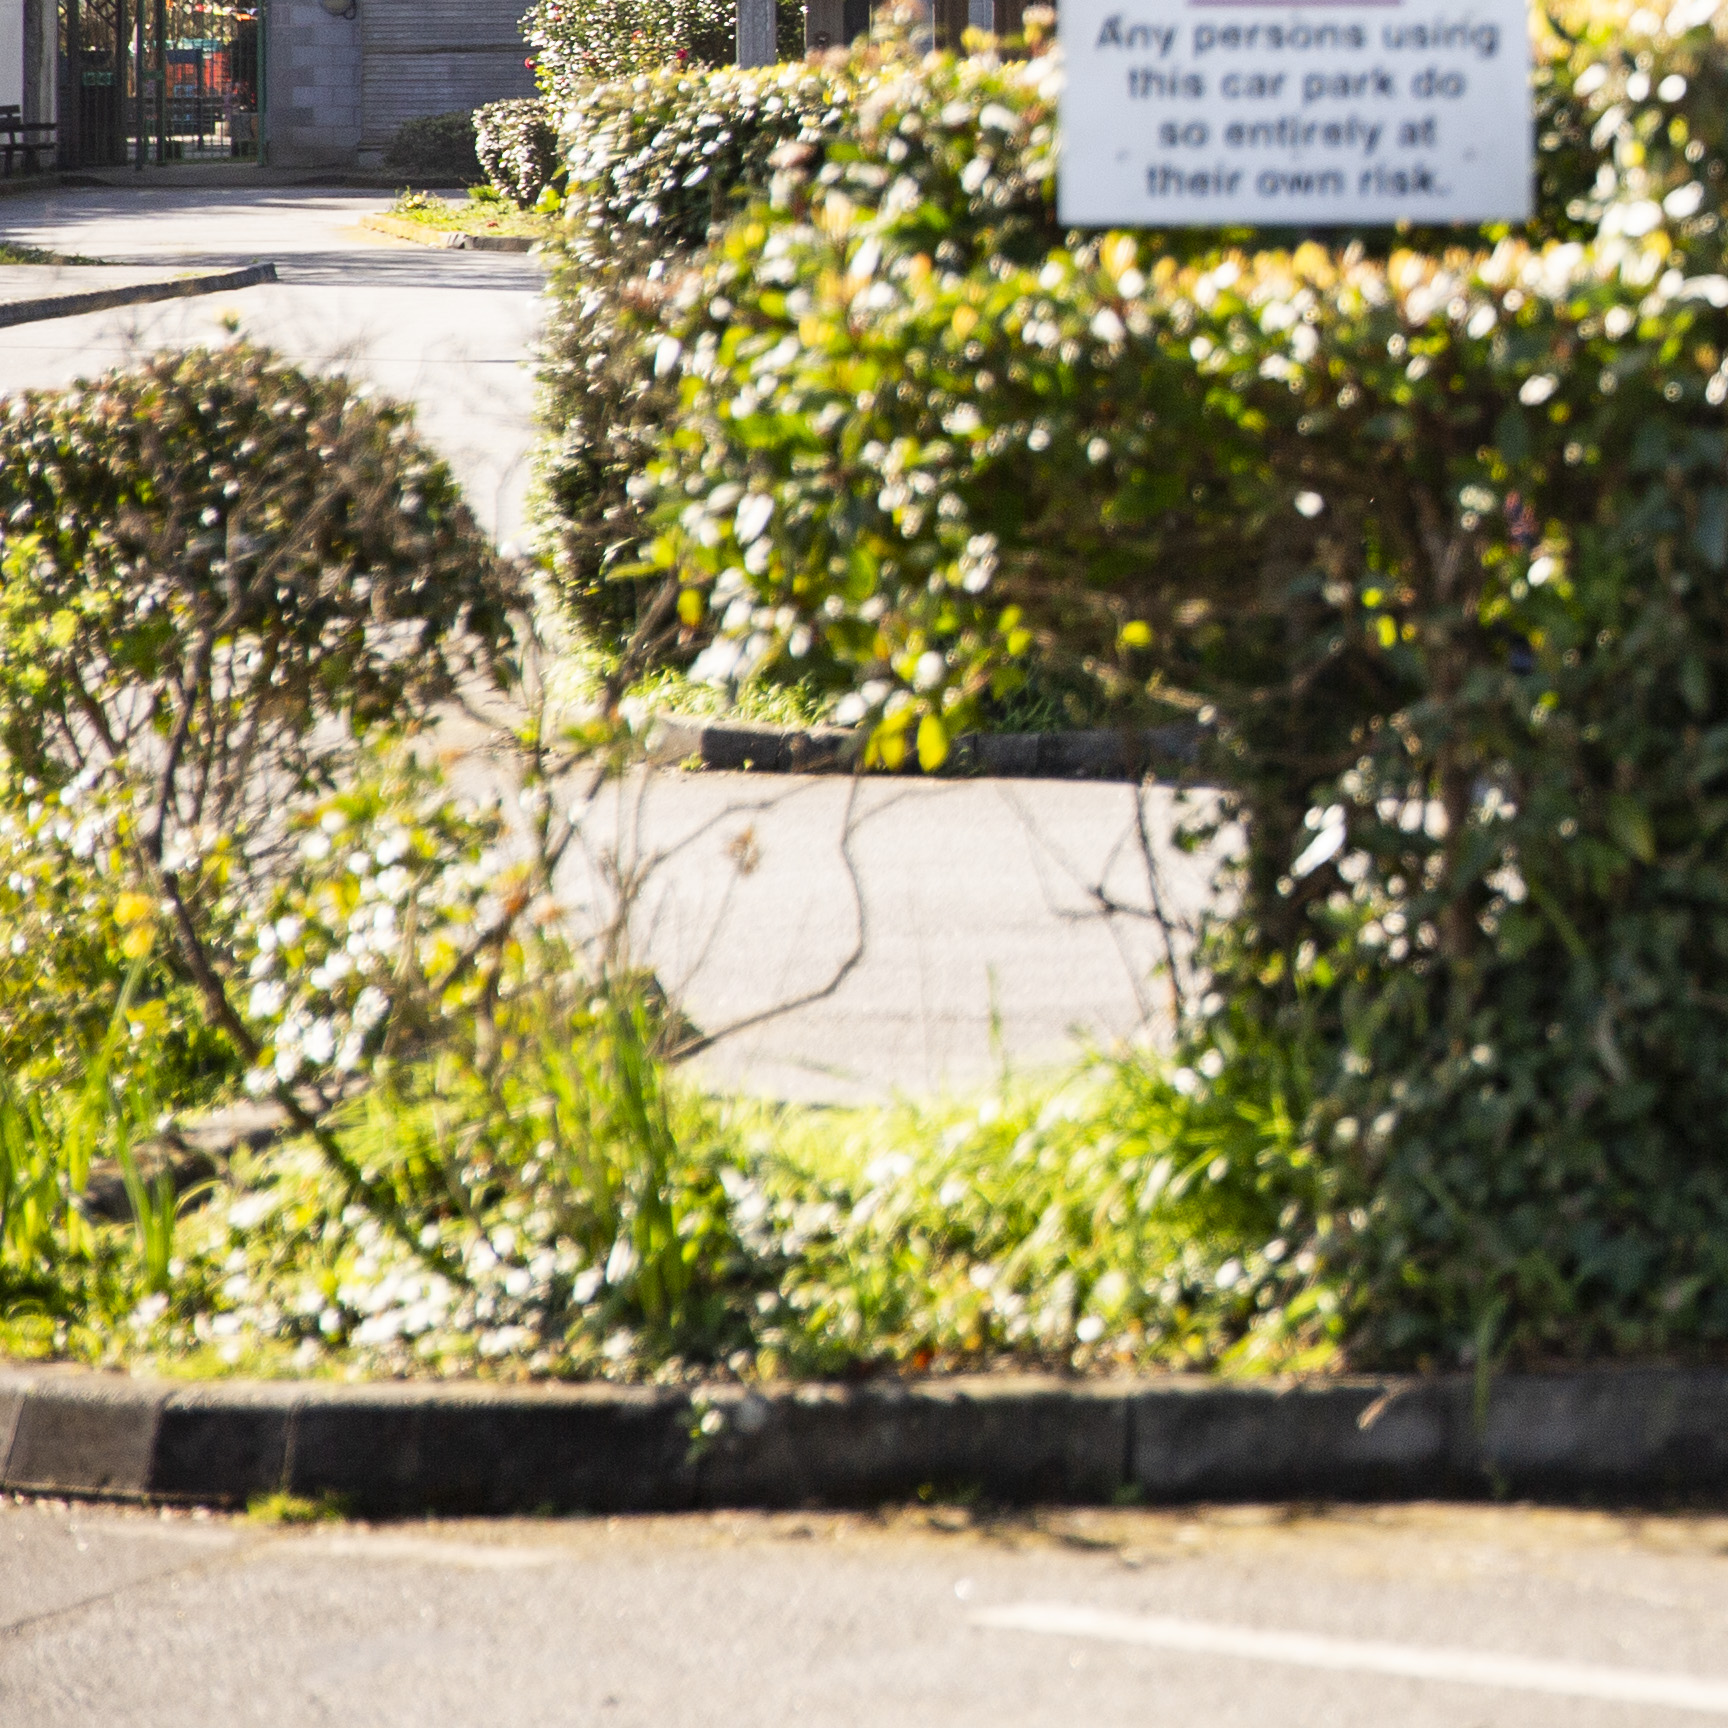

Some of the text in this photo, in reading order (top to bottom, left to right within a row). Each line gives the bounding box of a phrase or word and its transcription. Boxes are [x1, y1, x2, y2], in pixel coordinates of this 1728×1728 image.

[1097, 15, 1500, 57] Any persons using
[1129, 65, 1468, 104] this car park do
[1158, 114, 1438, 156] so entirely at
[1145, 163, 1451, 198] their own risk.
